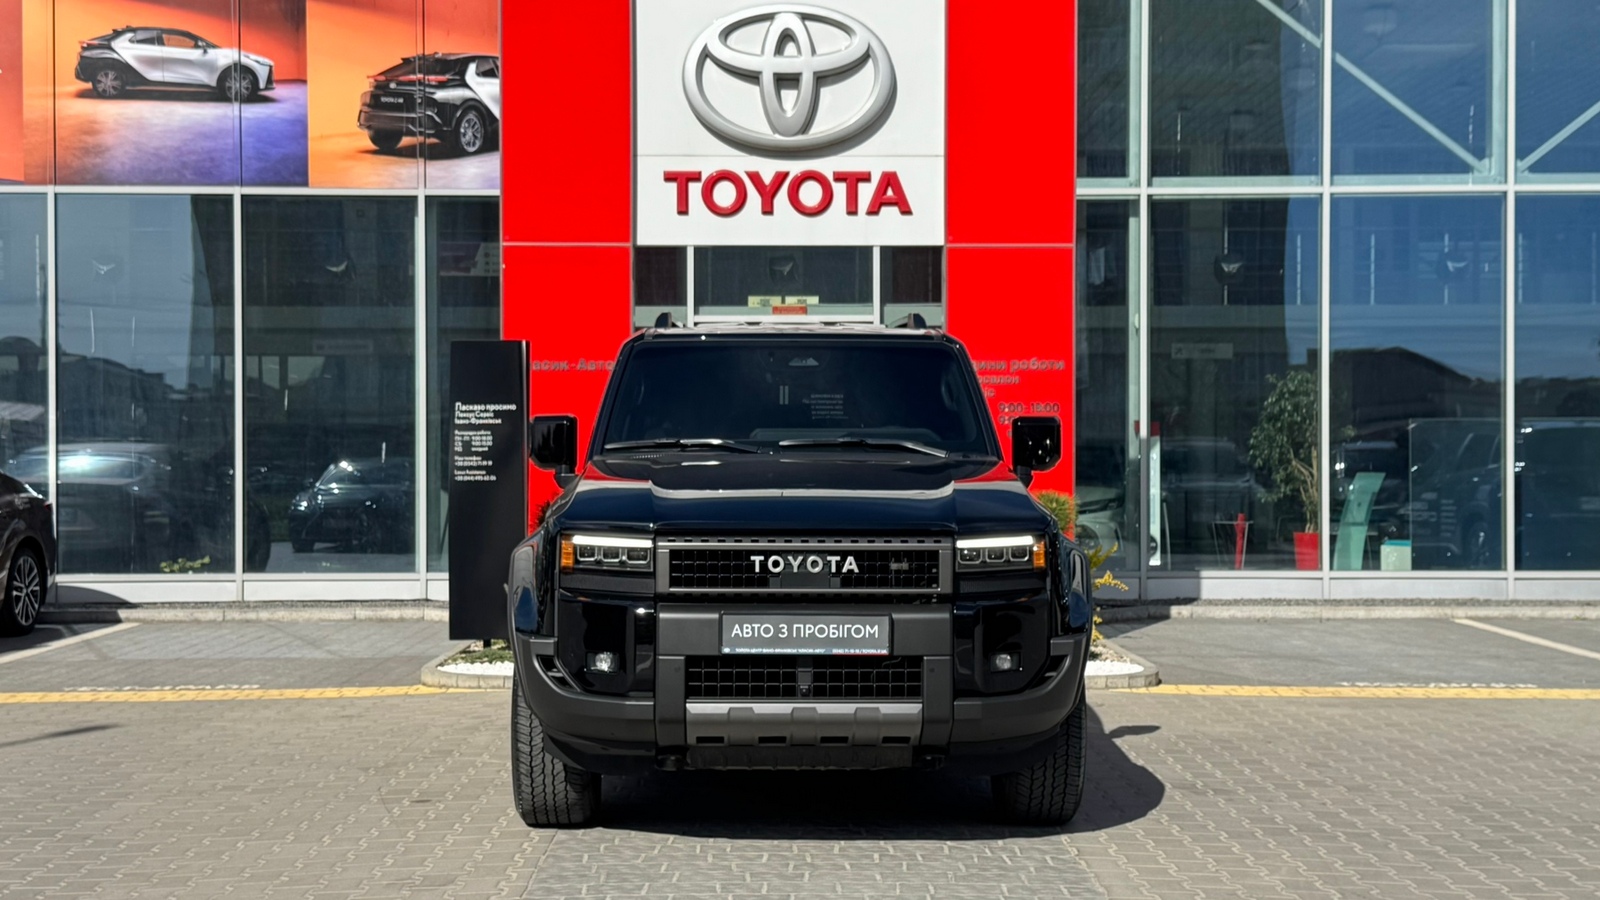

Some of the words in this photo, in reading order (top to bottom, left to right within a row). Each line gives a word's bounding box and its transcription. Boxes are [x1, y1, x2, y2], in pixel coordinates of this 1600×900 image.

[663, 169, 913, 217] TOYOTA
[532, 357, 615, 371] асик-Авто
[1010, 357, 1065, 373] роботи
[750, 555, 860, 574] TOYOTA
[731, 623, 774, 638] АВТО
[778, 624, 788, 638] З
[793, 624, 879, 639] ПРОБІГОМ
